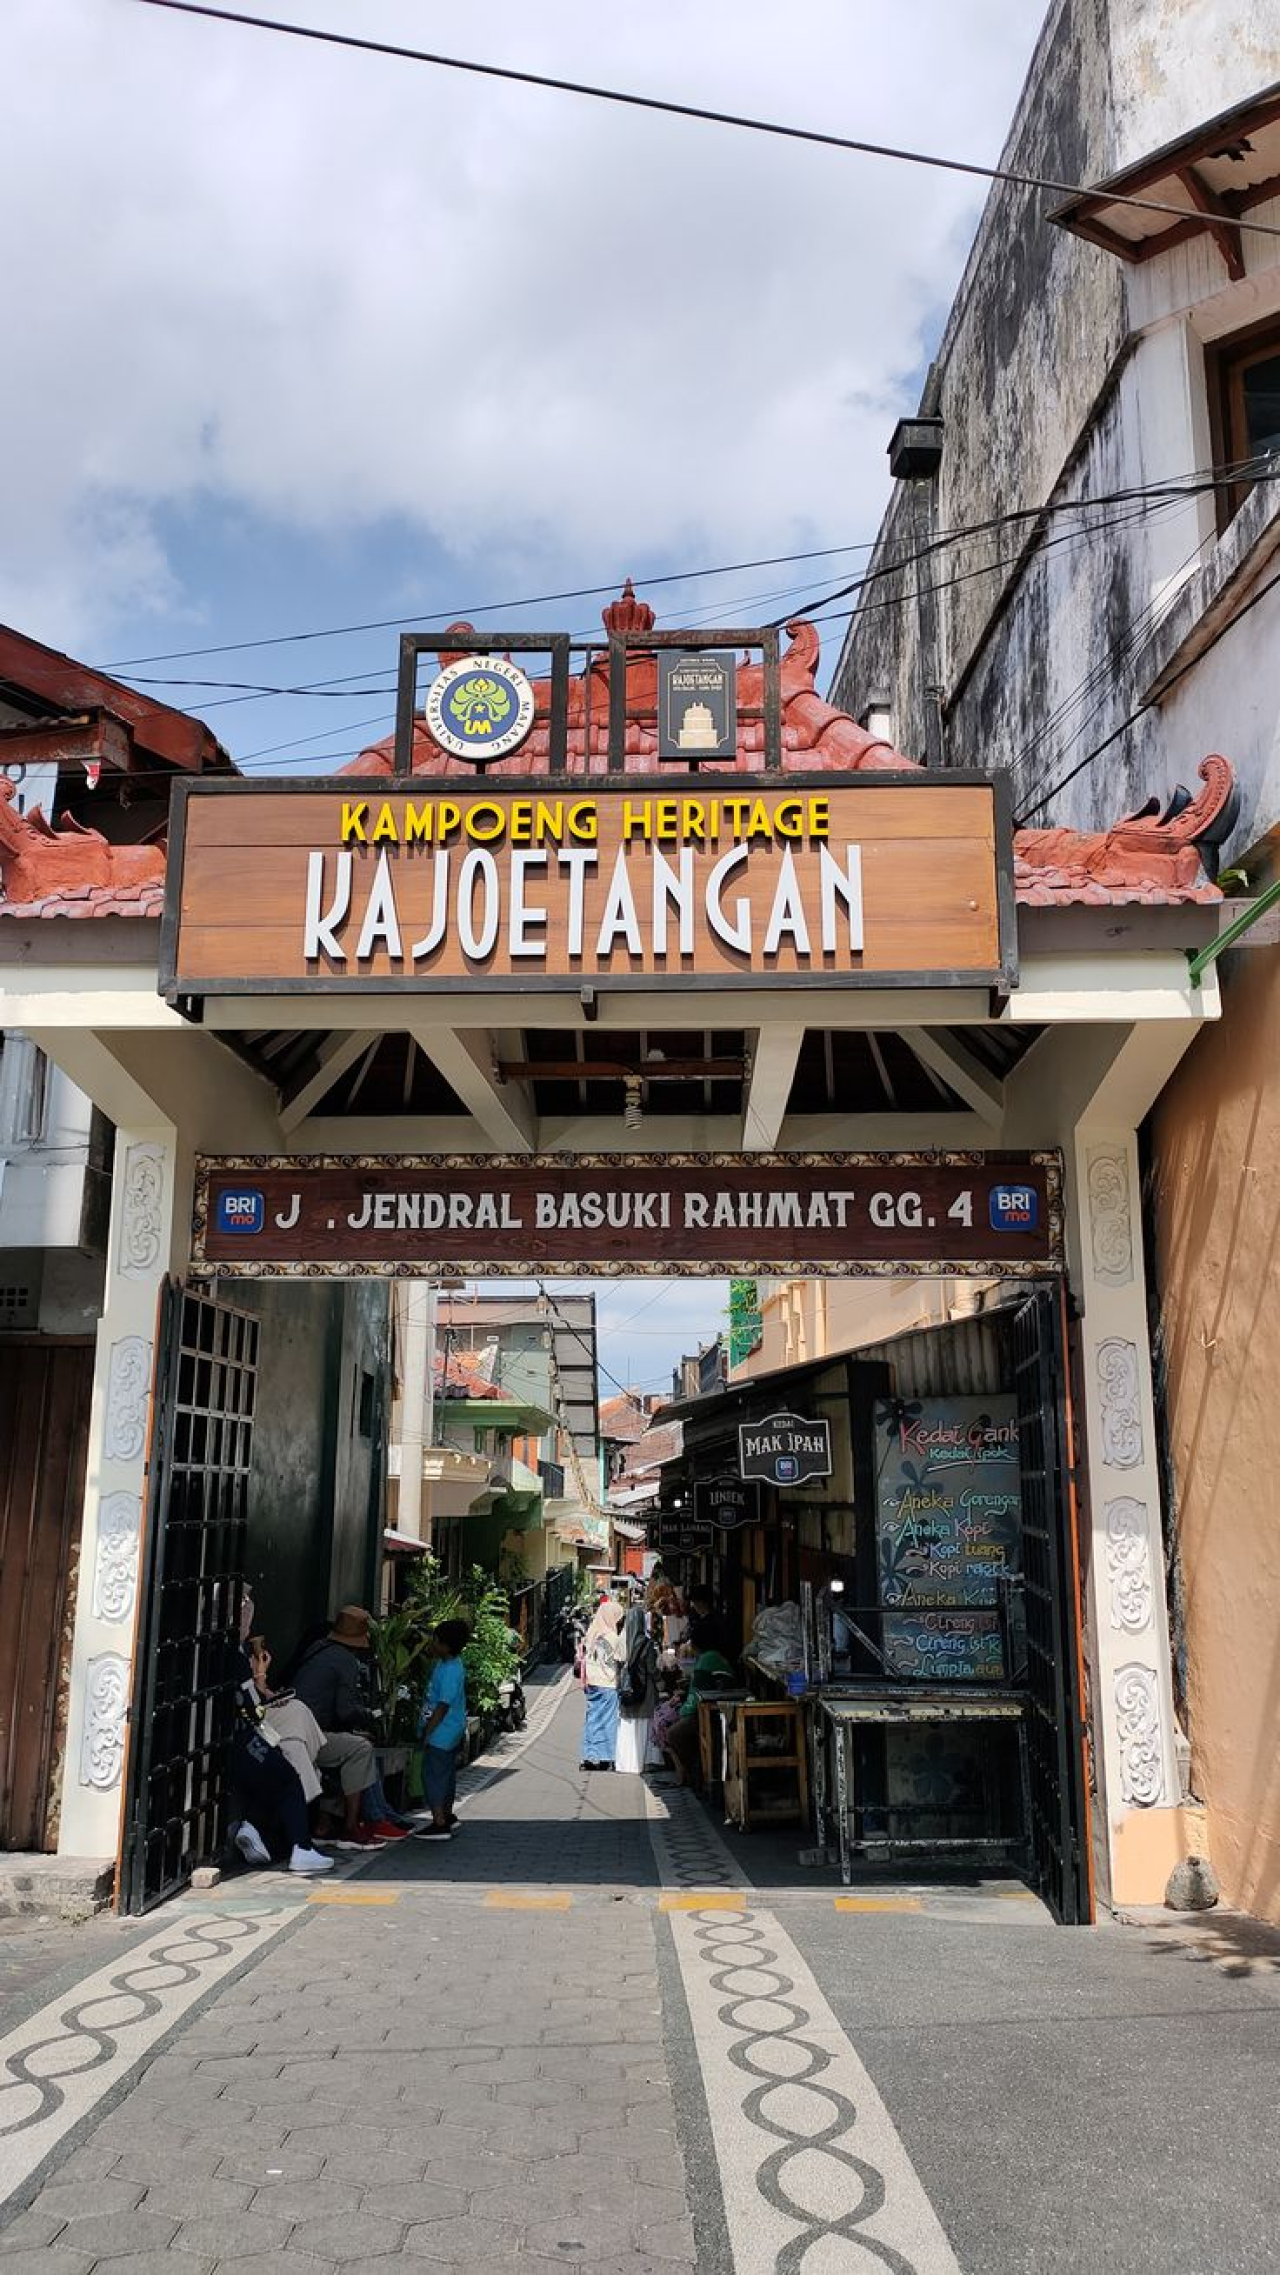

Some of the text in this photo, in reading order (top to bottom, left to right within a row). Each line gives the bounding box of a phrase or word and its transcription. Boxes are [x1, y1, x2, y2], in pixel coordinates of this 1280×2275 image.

[473, 660, 523, 686] NEGERI
[464, 719, 493, 735] UM
[491, 700, 530, 750] MALANG
[341, 797, 830, 842] KAMPOENG HERITAGE
[303, 842, 864, 960] KAJOETANGAN
[225, 1196, 256, 1213] BRI
[348, 1193, 523, 1229] JENDRAL
[535, 1192, 670, 1229] BASUKI
[684, 1191, 855, 1228] RAHMAT
[868, 1191, 936, 1228] GG.
[948, 1190, 973, 1227] 4
[997, 1192, 1030, 1210] BRI
[230, 1215, 255, 1226] mo
[1004, 1210, 1031, 1222] mo
[745, 1432, 825, 1457] MAK IPAH
[900, 1420, 966, 1455] Kedai
[897, 1487, 953, 1519] Aneka
[896, 1517, 993, 1547] Aneka Kopi
[929, 1542, 960, 1559] Kopi
[929, 1560, 962, 1579] Kopi
[902, 1582, 956, 1606] Aneka
